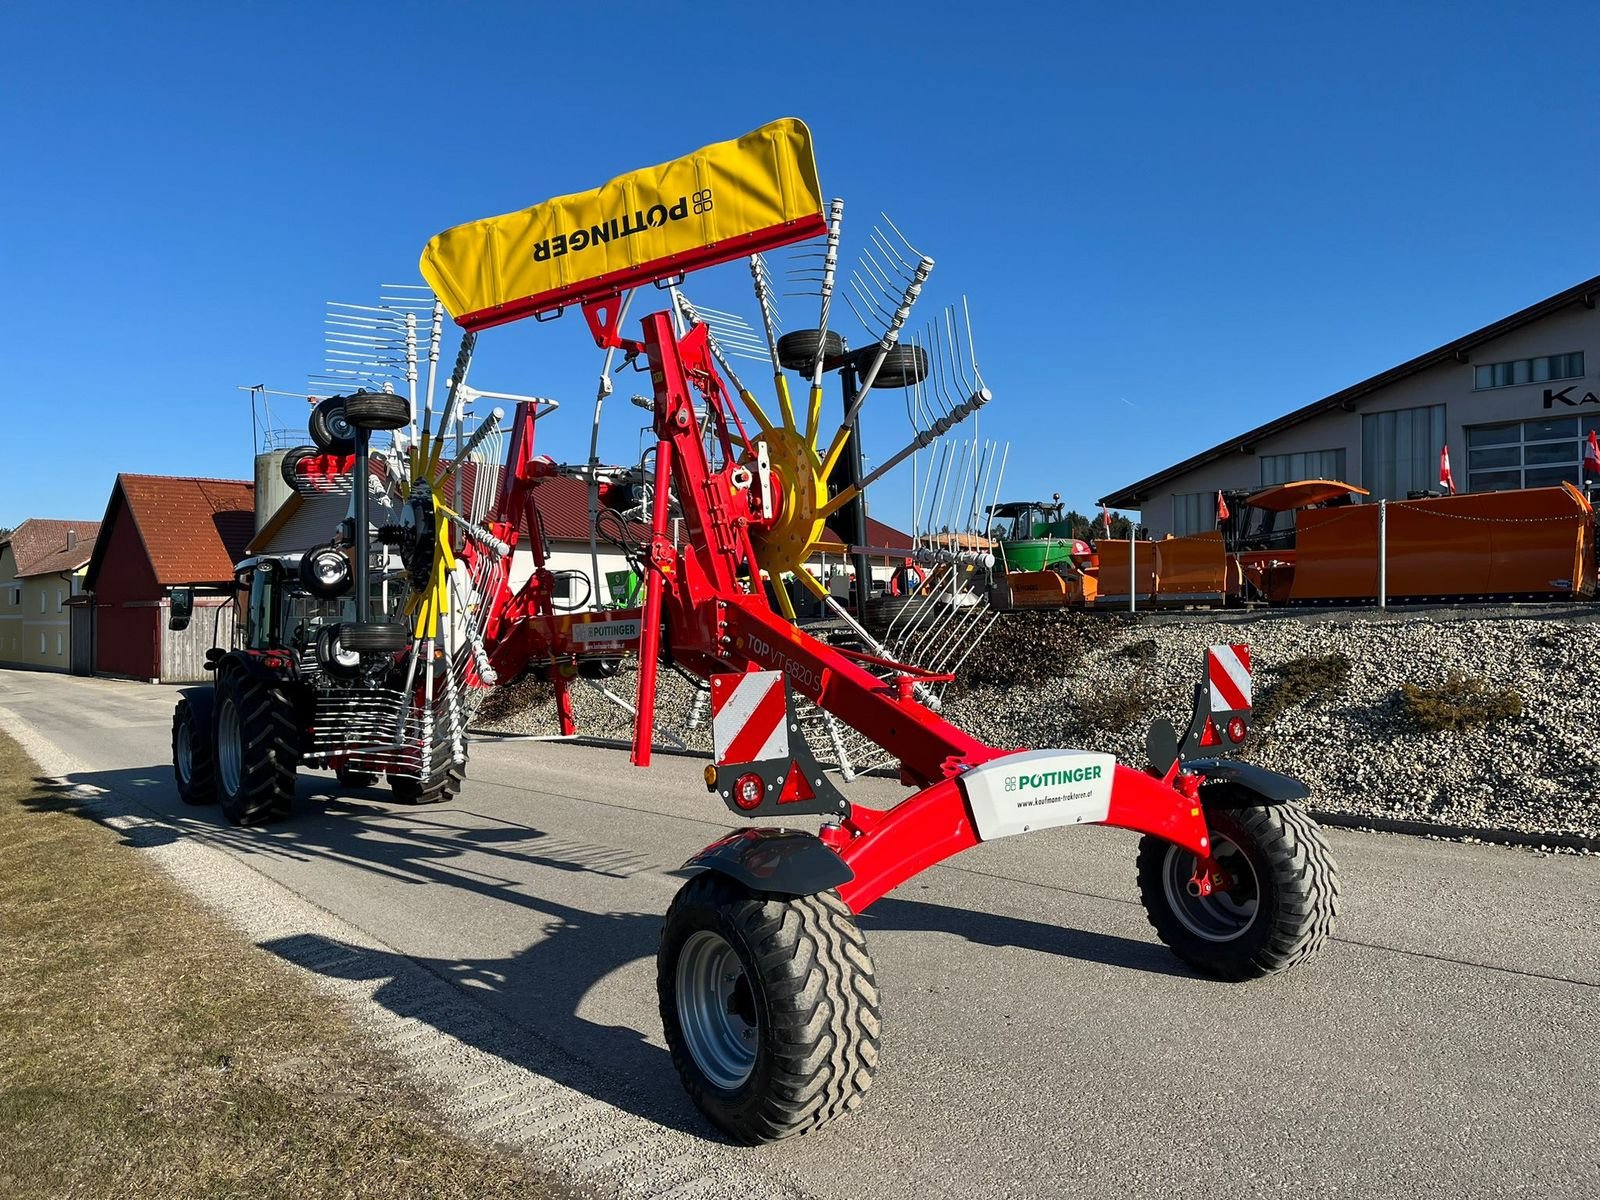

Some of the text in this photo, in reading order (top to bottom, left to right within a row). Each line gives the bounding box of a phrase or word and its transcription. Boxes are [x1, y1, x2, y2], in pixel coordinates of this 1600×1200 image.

[747, 633, 820, 691] TOP VT 6820 S
[1017, 790, 1093, 808] www.kaufmann-traktoren.at
